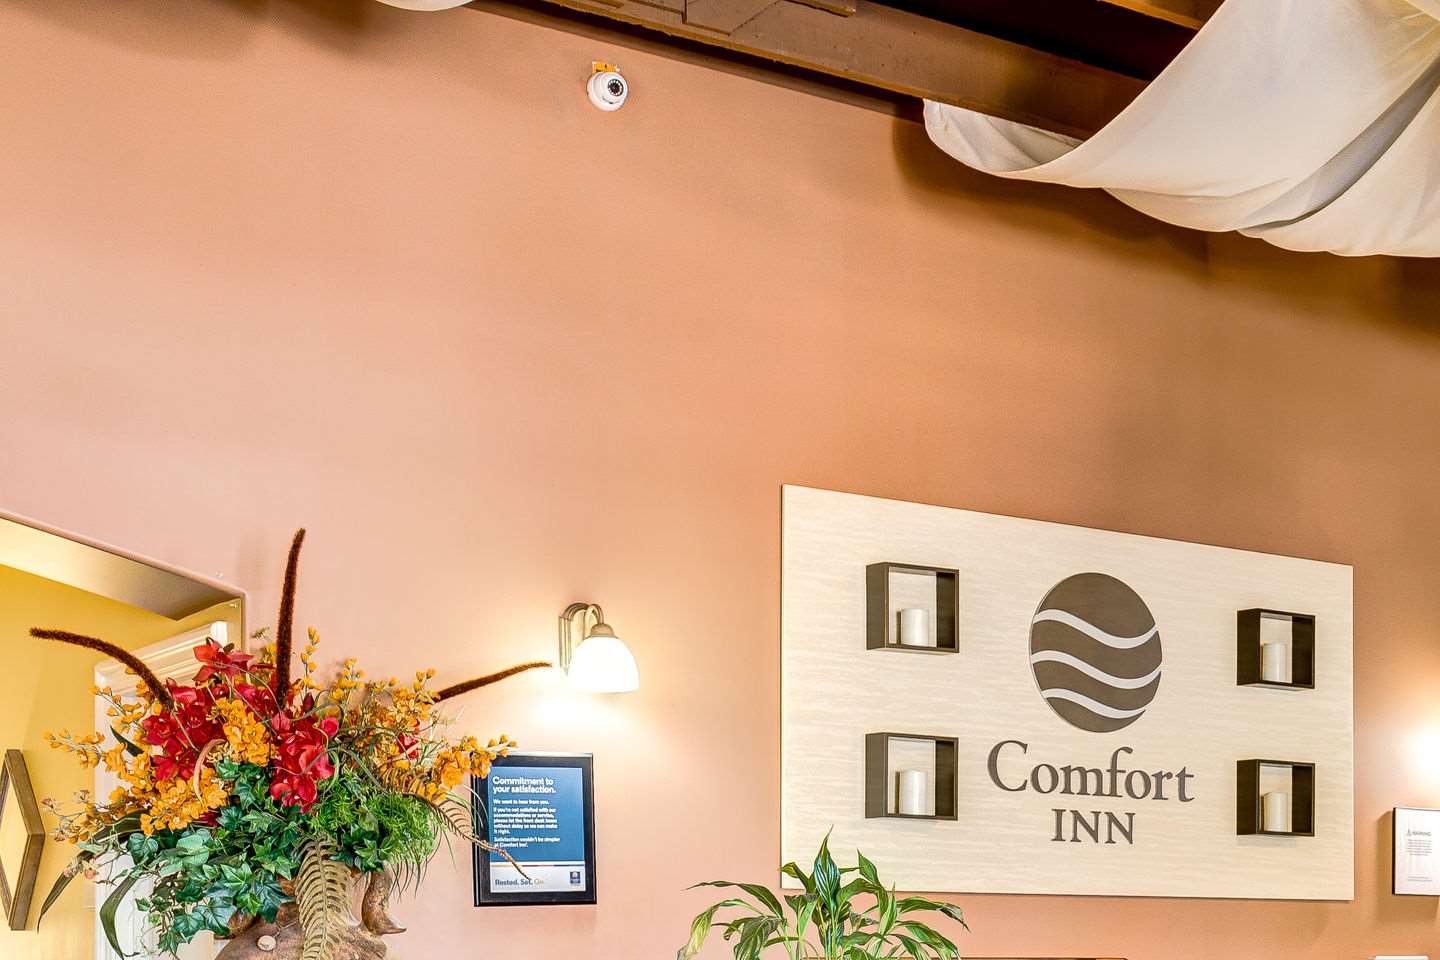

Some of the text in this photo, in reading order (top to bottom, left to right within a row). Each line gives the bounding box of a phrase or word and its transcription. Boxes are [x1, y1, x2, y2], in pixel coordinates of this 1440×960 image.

[493, 776, 554, 785] Commitment to
[987, 740, 1195, 802] Comfort
[493, 785, 557, 794] your satisfaction.
[1051, 808, 1136, 845] INN
